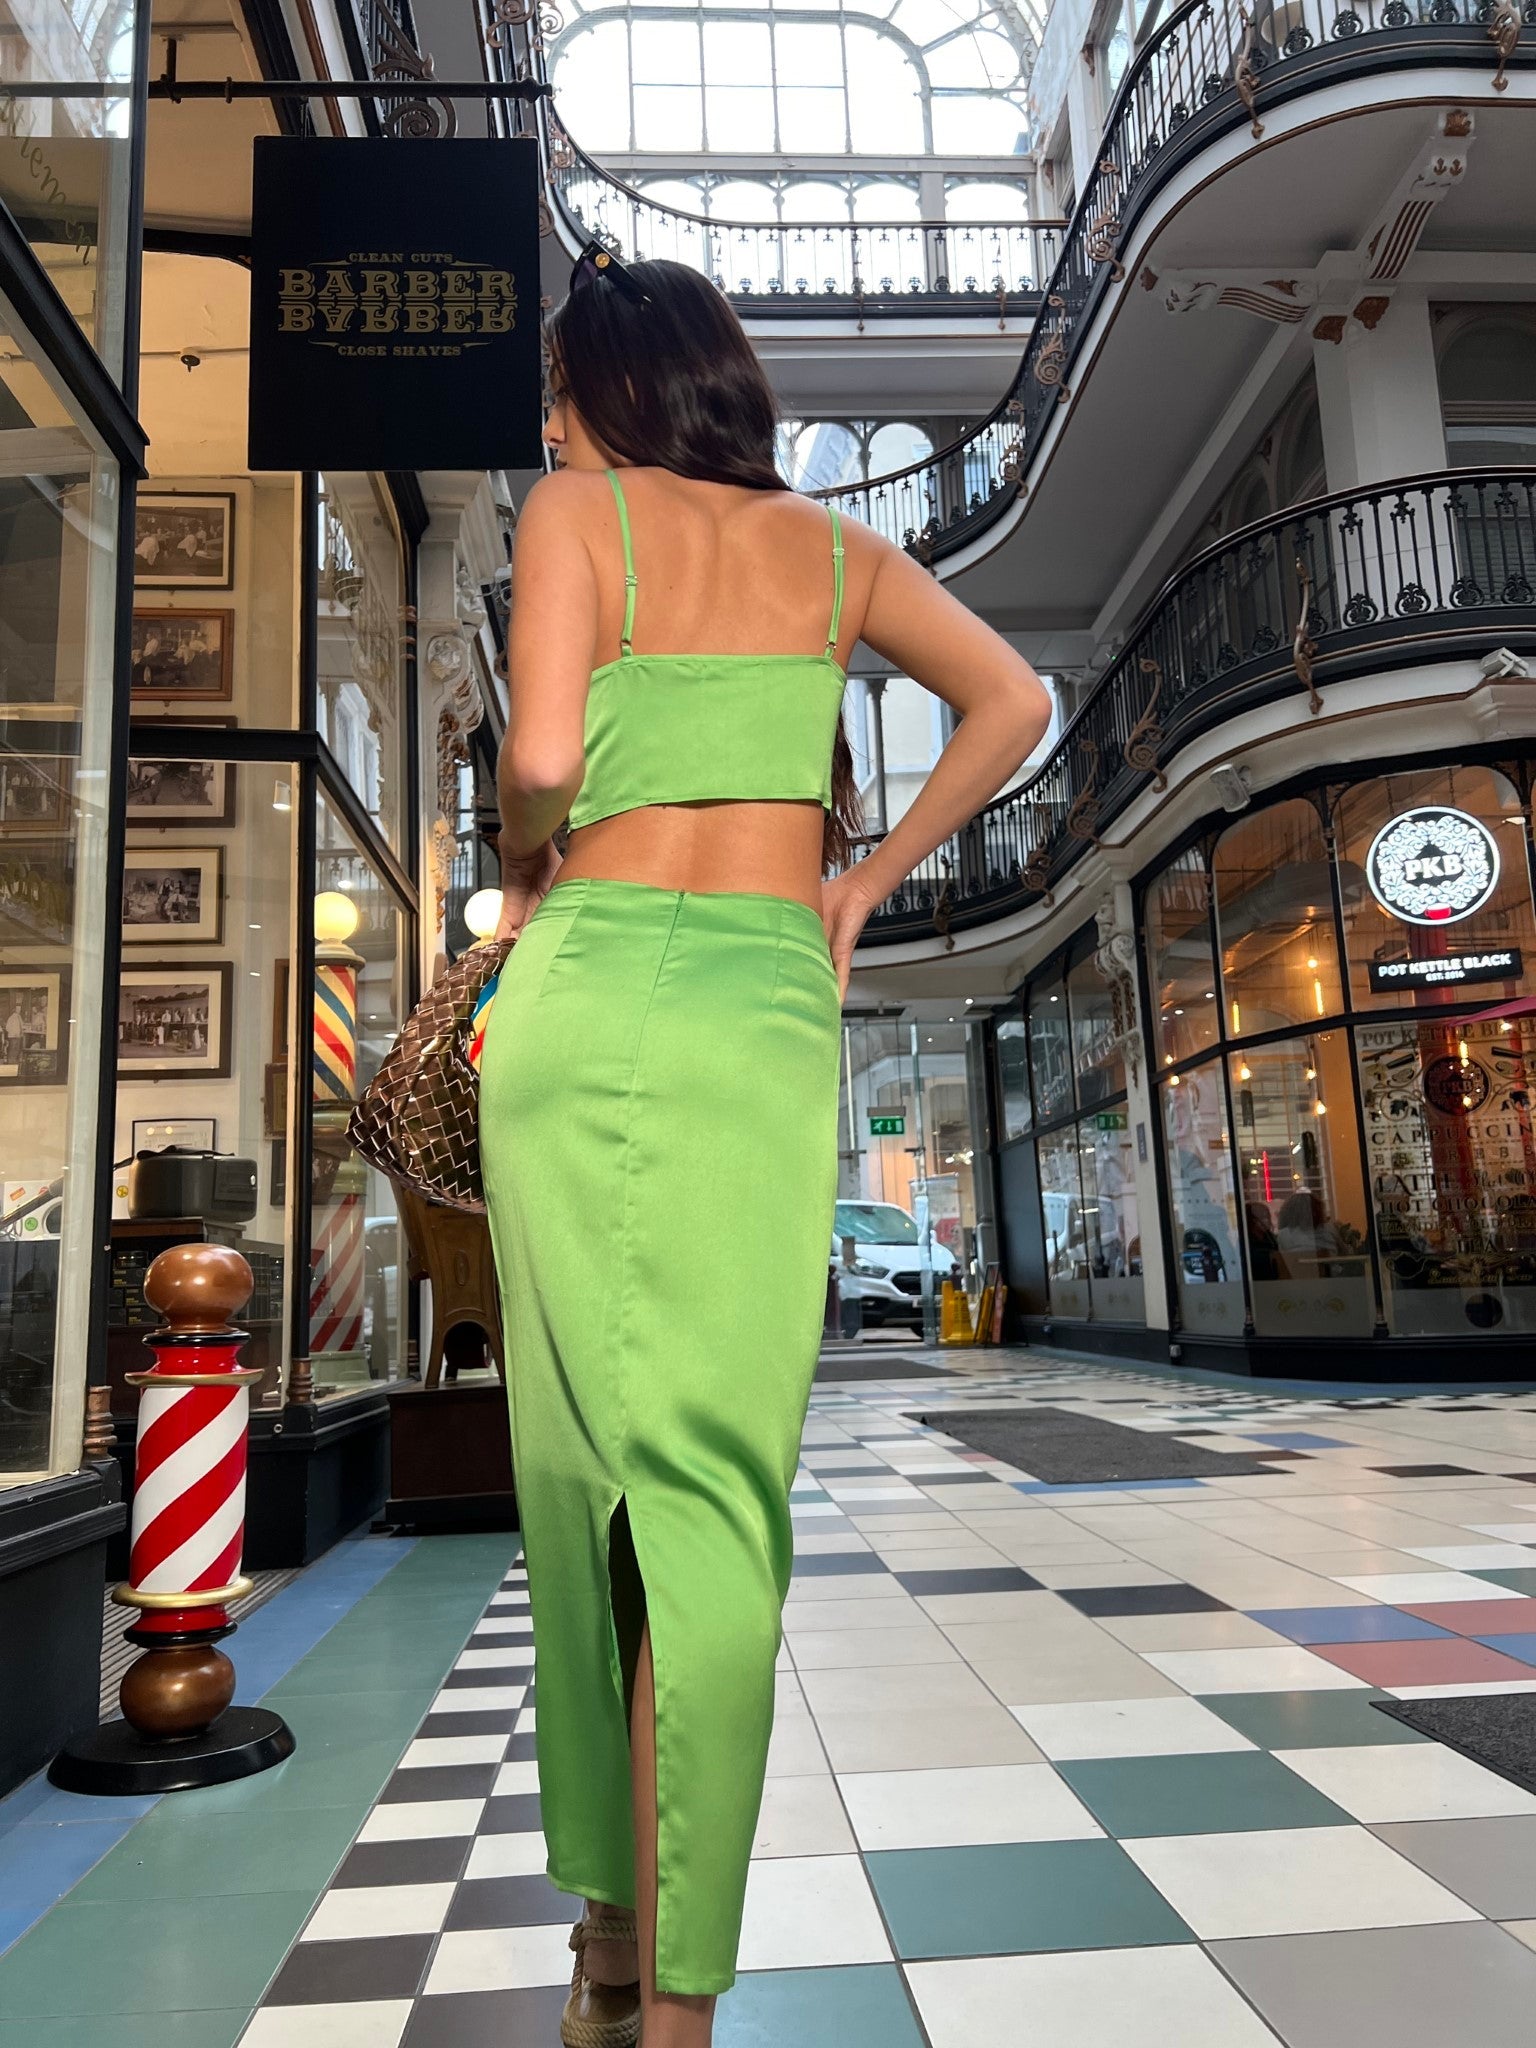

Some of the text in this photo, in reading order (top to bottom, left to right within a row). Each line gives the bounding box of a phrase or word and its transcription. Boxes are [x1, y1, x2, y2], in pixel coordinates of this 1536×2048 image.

[349, 252, 454, 264] CLEAN CUTS
[278, 269, 518, 301] BARBER
[337, 345, 462, 357] CLOSE SHAVES
[1402, 853, 1464, 881] PKB
[1378, 953, 1512, 978] POT KETTLE BLACK
[1362, 1030, 1396, 1048] POT
[1381, 1199, 1425, 1214] HOT
